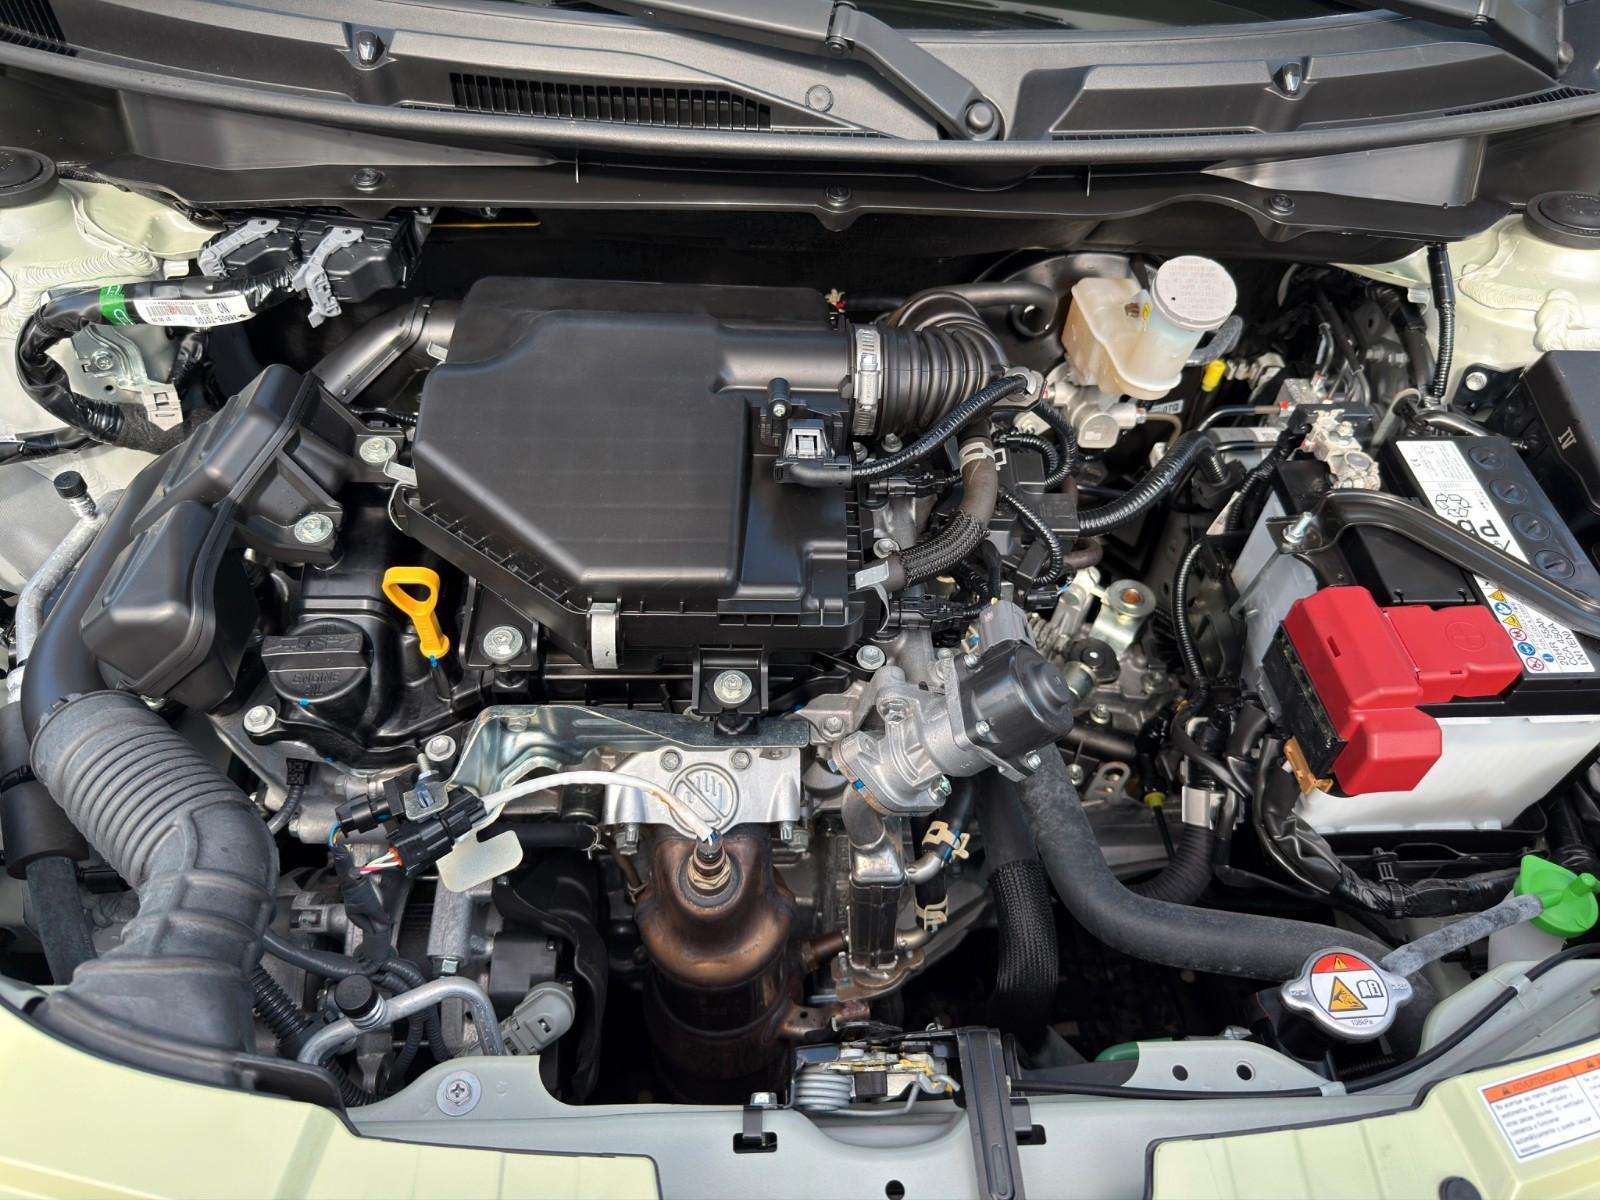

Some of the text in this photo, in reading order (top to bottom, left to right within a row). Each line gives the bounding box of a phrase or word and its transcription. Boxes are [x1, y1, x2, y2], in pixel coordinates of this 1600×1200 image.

[1548, 623, 1579, 666] CCA 450A
[1550, 641, 1569, 666] 20HR
[292, 671, 341, 684] ENGINE
